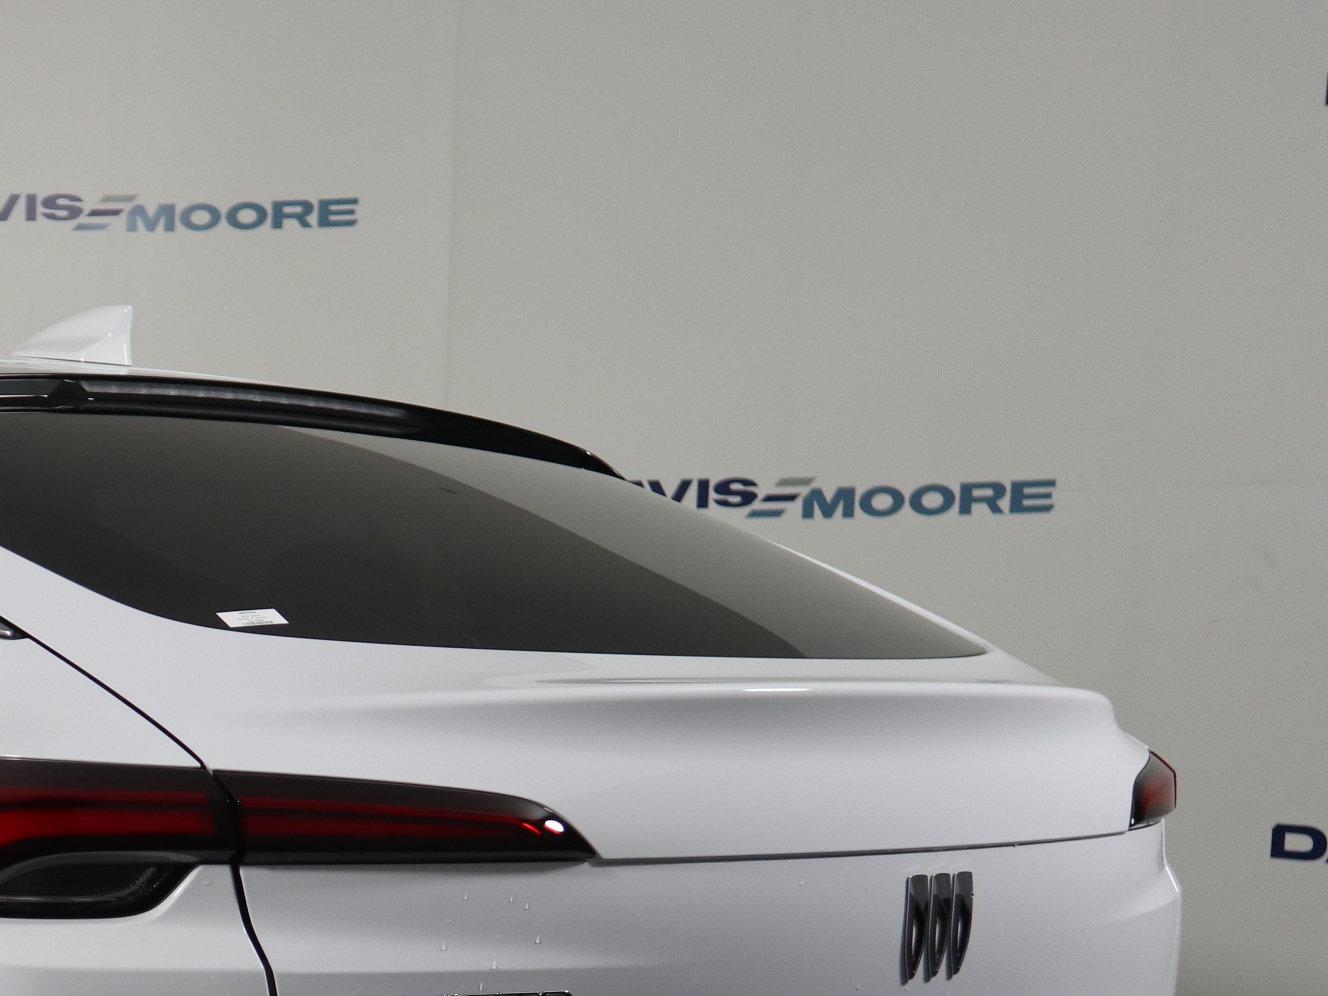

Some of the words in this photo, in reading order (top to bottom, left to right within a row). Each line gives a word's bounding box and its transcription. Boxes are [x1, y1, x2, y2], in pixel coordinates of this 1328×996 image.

[125, 198, 359, 232] MOORE
[628, 477, 758, 508] VIS
[801, 479, 1057, 518] MOORE
